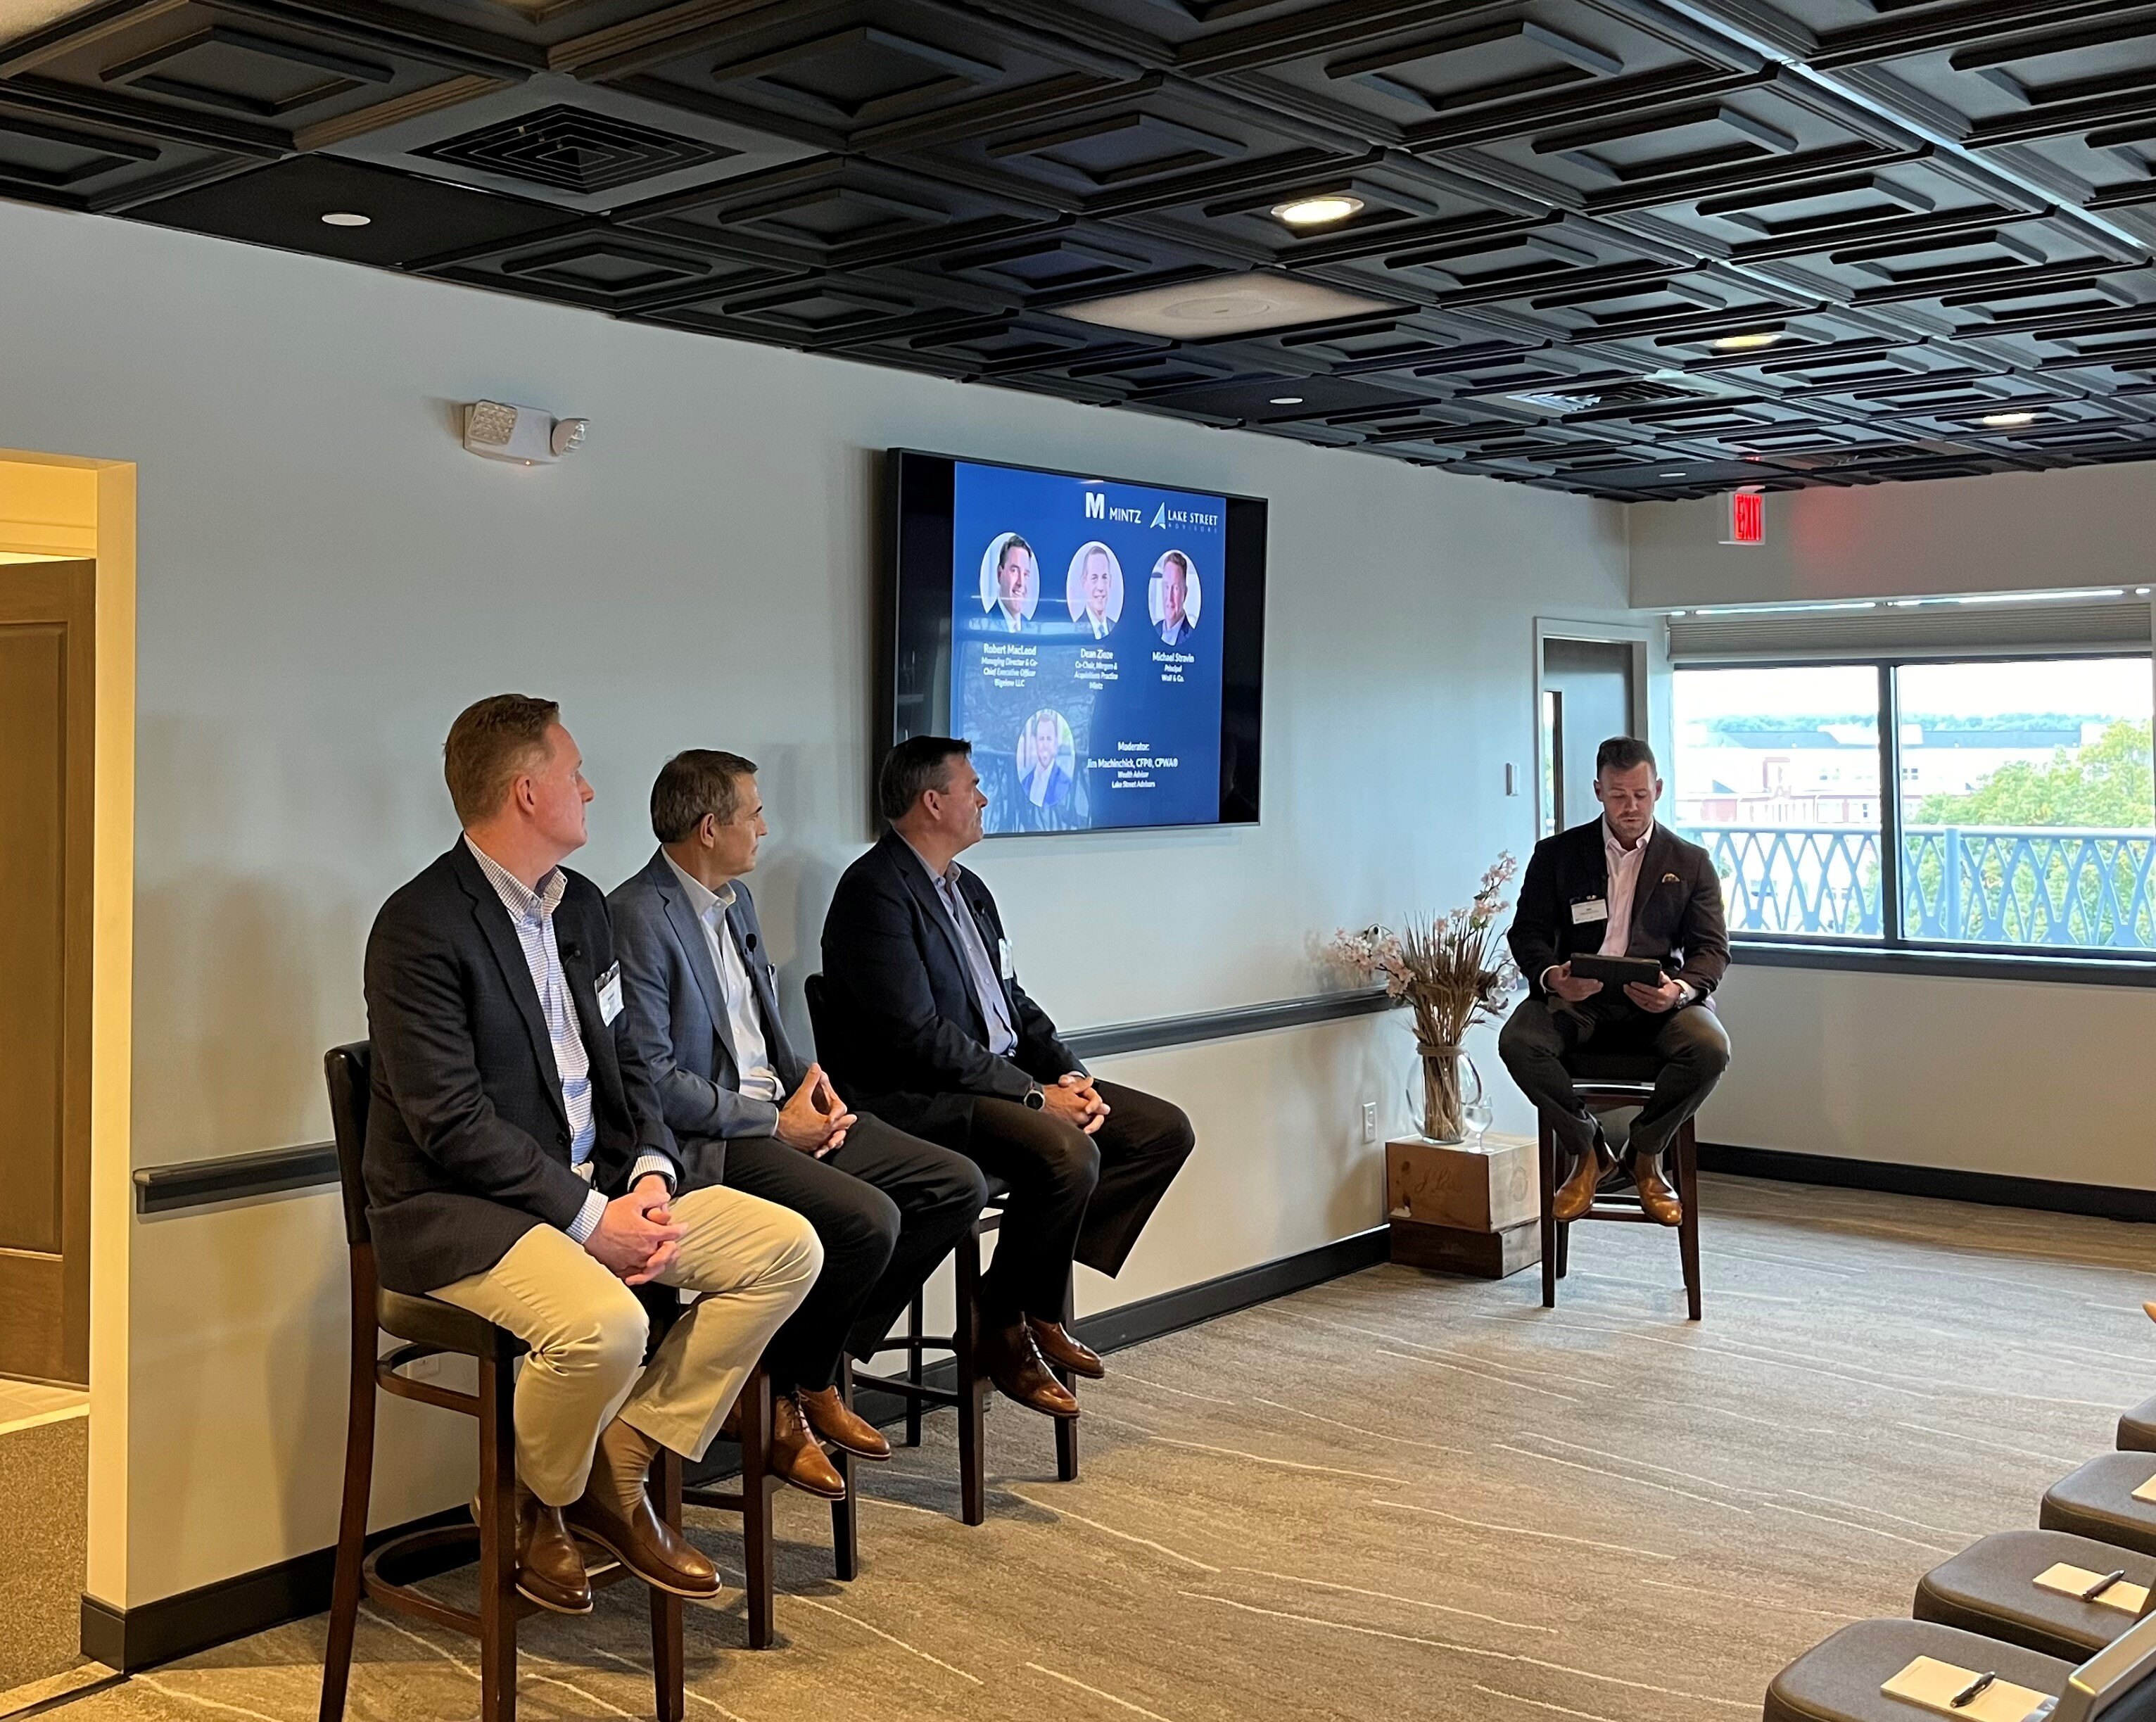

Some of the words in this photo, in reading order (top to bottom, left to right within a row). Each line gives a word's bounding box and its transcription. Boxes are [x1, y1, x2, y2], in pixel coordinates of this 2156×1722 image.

[1086, 492, 1105, 519] M
[1109, 507, 1142, 524] MINTZ
[1168, 509, 1188, 523] LAKE
[1190, 512, 1219, 526] STREET
[1735, 494, 1761, 540] EXIT
[984, 642, 1006, 654] Robert
[1007, 644, 1037, 656] MacLeod
[1081, 648, 1096, 659] Dean
[1153, 651, 1174, 662] Michael
[984, 667, 996, 676] Chief
[1015, 678, 1025, 688] LLC
[1118, 742, 1149, 751] Moderator:
[1087, 759, 1097, 768] Jim
